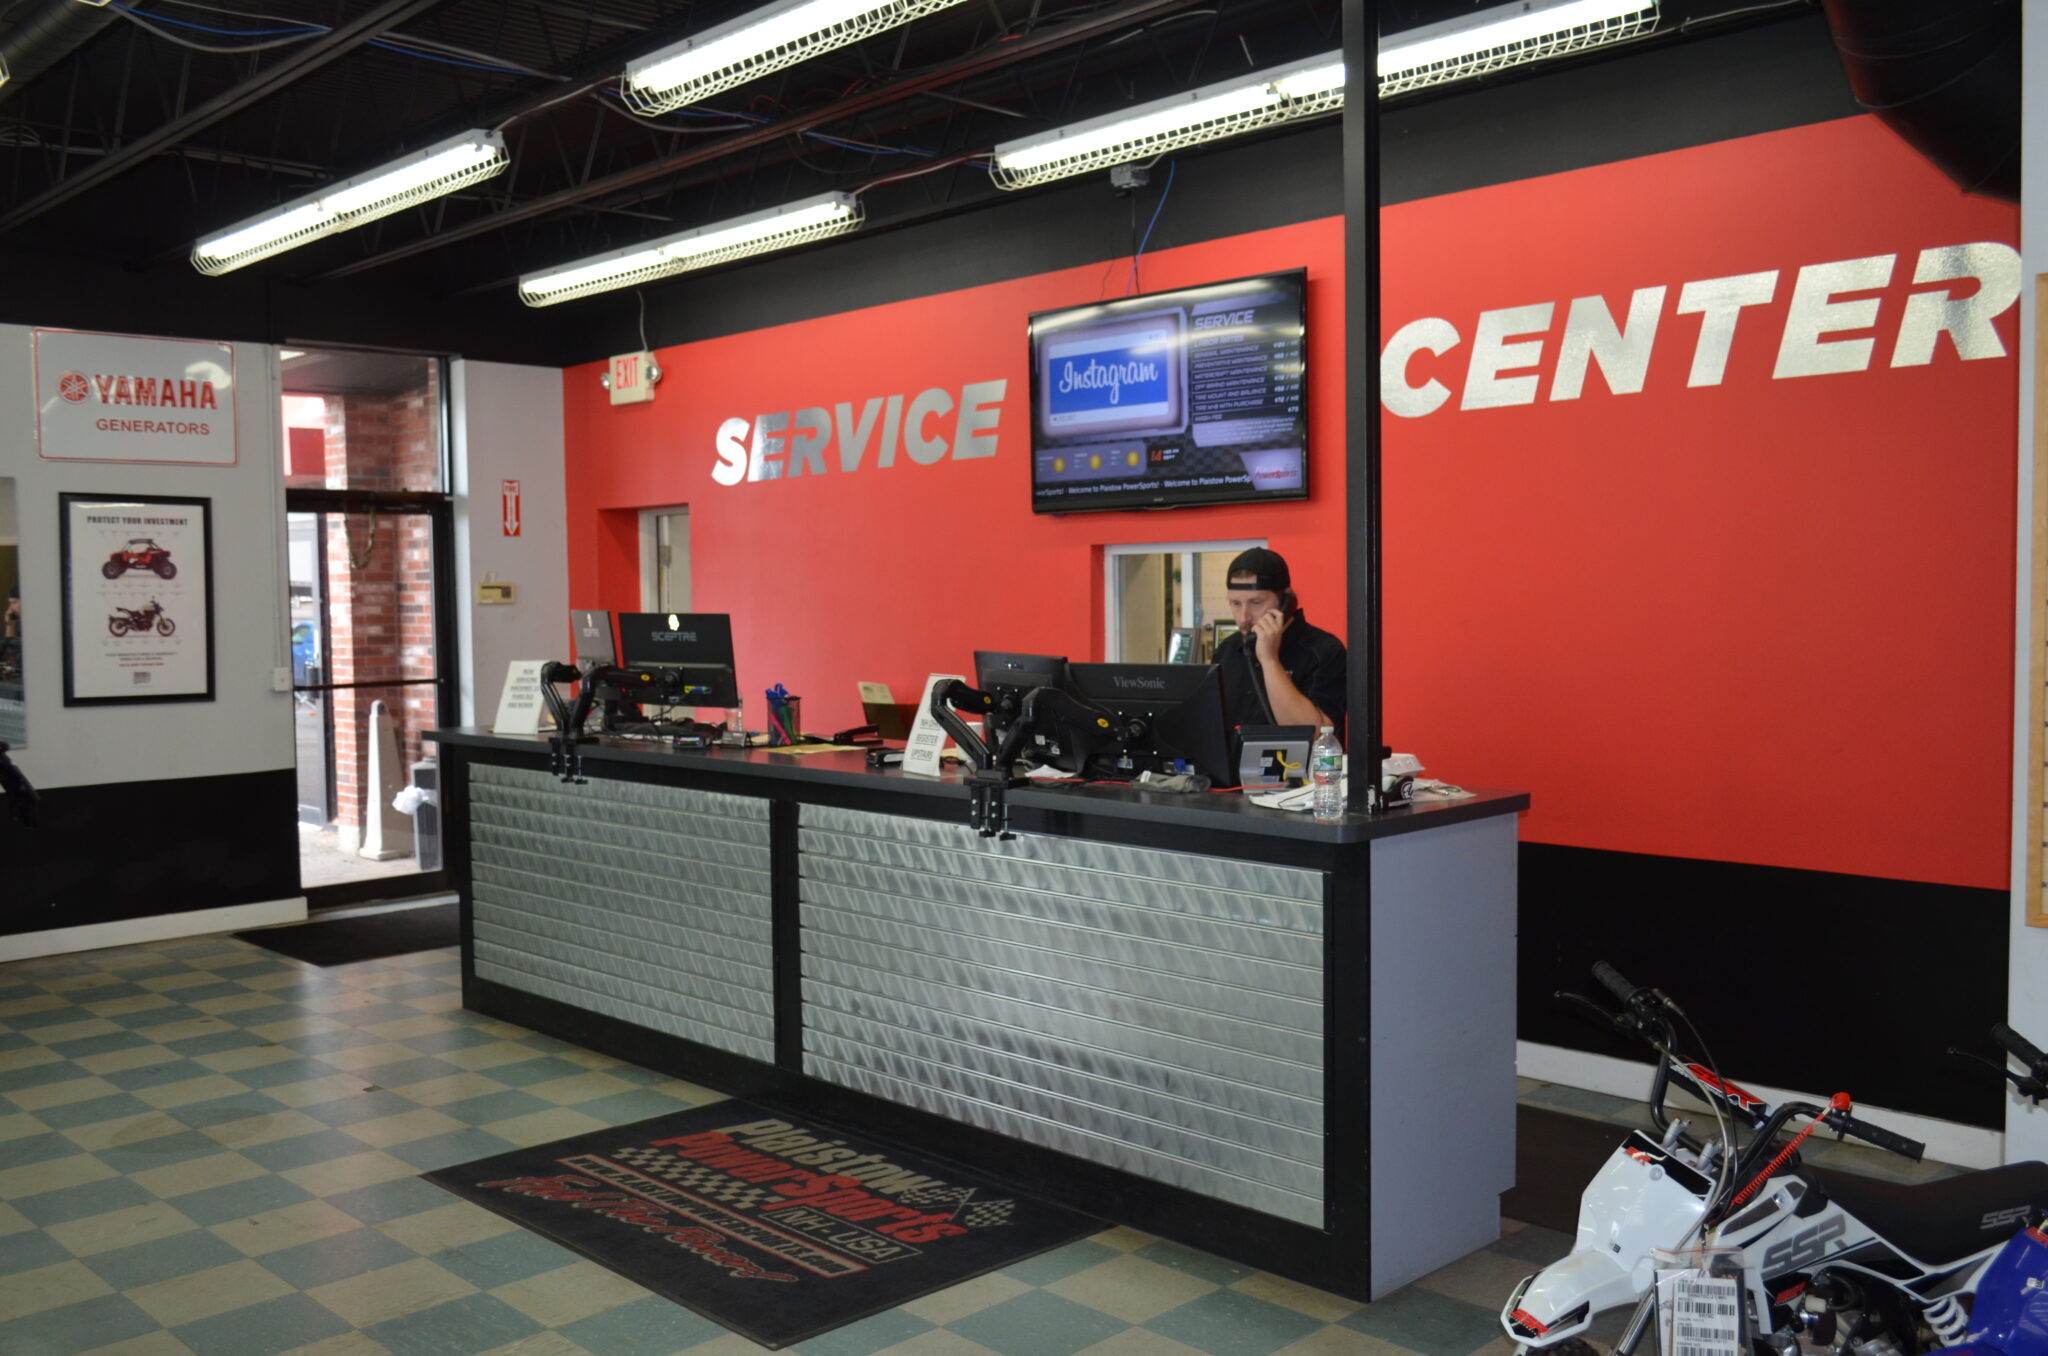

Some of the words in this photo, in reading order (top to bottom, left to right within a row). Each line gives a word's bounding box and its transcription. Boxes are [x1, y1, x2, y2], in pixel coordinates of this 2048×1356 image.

[1194, 310, 1255, 330] SERVICE
[1380, 241, 2023, 418] CENTER
[615, 356, 639, 389] EXIT
[1059, 359, 1159, 405] Instagram
[94, 375, 219, 409] YAMAHA
[95, 418, 210, 435] GENERATORS
[711, 378, 1008, 486] SERVICE
[87, 516, 120, 525] PROTECT
[651, 631, 697, 642] SCEPTRE
[1113, 676, 1166, 689] ViewSonic
[710, 1118, 948, 1195] Plaistow
[649, 1130, 969, 1243] PowerSports
[1980, 1205, 2033, 1230] SSR
[1760, 1212, 1850, 1281] SSR
